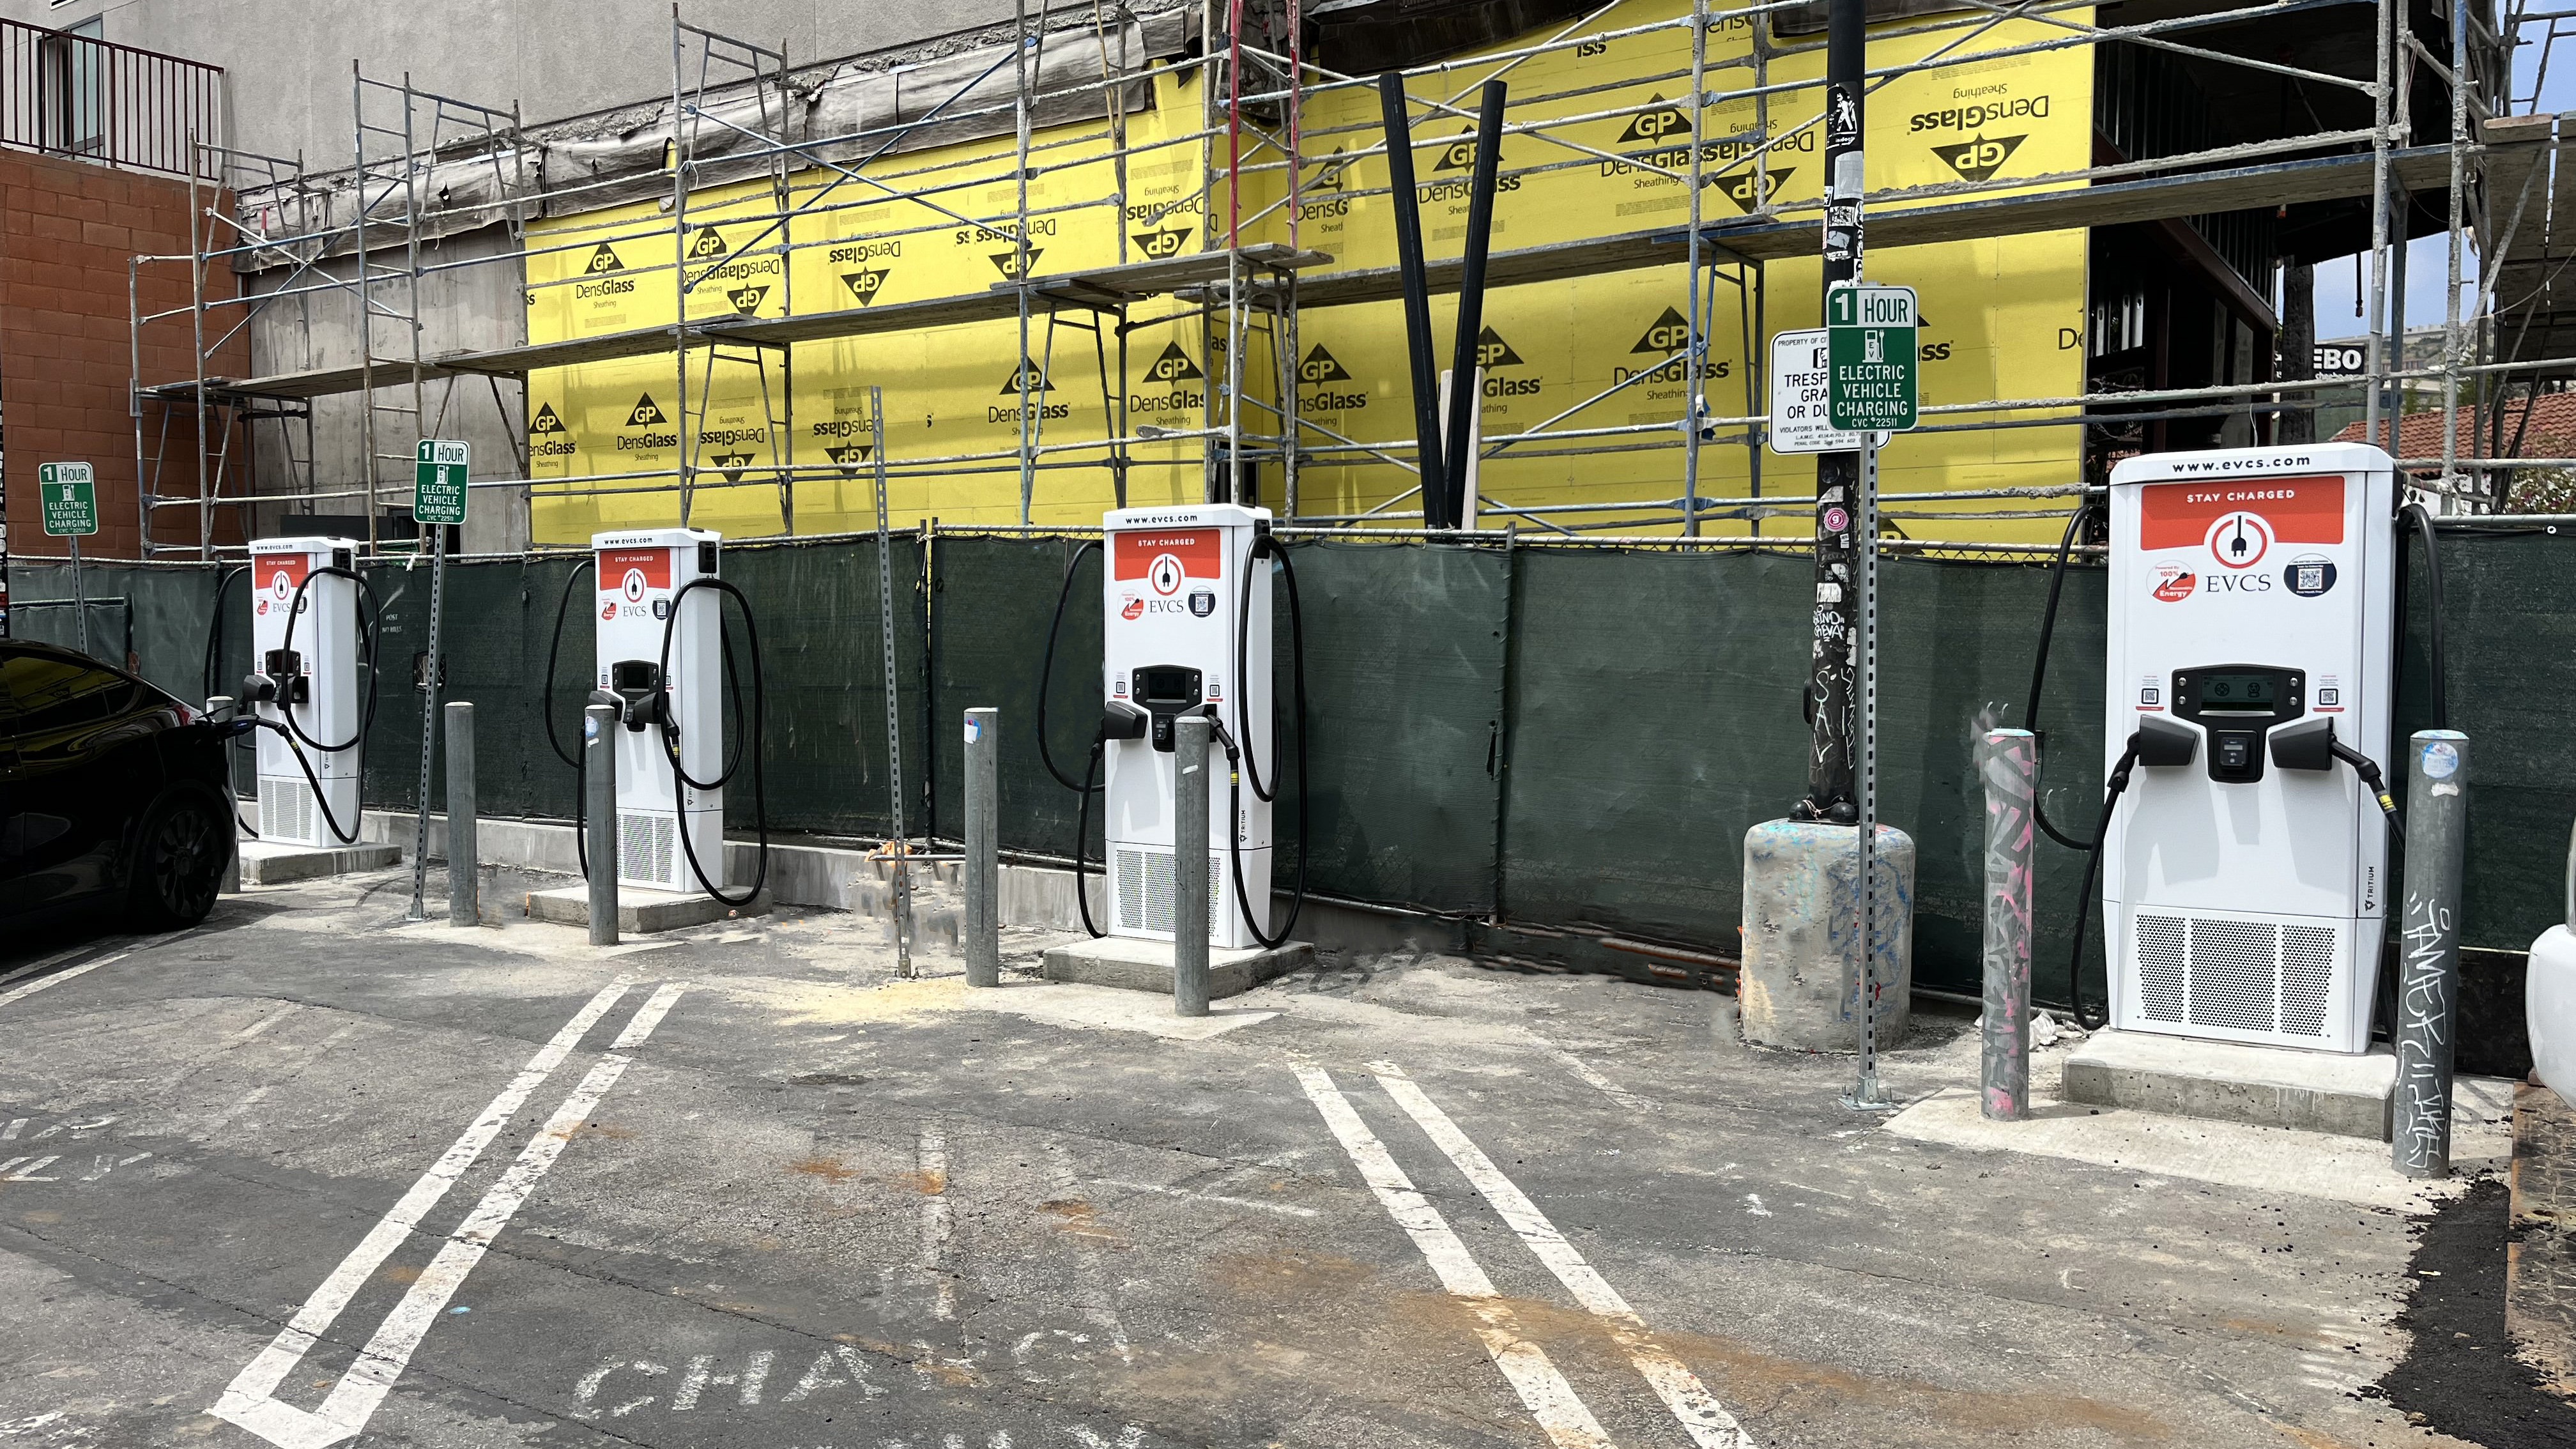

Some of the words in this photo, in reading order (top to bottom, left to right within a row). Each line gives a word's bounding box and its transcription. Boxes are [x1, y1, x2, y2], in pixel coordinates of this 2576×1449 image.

[1953, 84, 2007, 99] Sheathing
[1910, 96, 2049, 132] DensGlass
[1636, 111, 1676, 135] GP
[1955, 142, 2005, 169] GP
[1145, 185, 1179, 195] Sheathing
[697, 237, 719, 254] GP
[1147, 233, 1179, 254] GP
[829, 241, 901, 264] DensGlass
[593, 253, 614, 272] GP
[576, 280, 634, 298] DensGlass
[697, 286, 722, 295] Sheathing
[853, 273, 880, 293] GP
[594, 300, 616, 309] Sheathing
[737, 290, 760, 307] GP
[1836, 293, 1848, 321] 1
[1865, 298, 1908, 323] HOUR
[1648, 326, 1688, 348] GP
[1156, 360, 1188, 378] GP
[1301, 361, 1335, 380] GP
[1839, 365, 1905, 380] ELECTRIC
[1843, 383, 1901, 398] VEHICLE
[634, 407, 656, 422] GP
[1788, 406, 1805, 418] OR
[1837, 401, 1908, 416] CHARGING
[535, 416, 556, 431] GP
[813, 418, 874, 437] ensGlass
[1156, 417, 1191, 425] Sheathing
[1852, 418, 1868, 427] CVC
[618, 433, 677, 450] DensGlass
[701, 428, 764, 445] DensGlass
[422, 443, 429, 459] 1
[438, 447, 464, 462] HOUR
[529, 441, 576, 457] ensGlass
[536, 460, 558, 468] Sheathing
[635, 453, 658, 461] Sheathing
[2172, 456, 2310, 473] www.evcs.com
[44, 466, 52, 480] 1
[61, 468, 88, 481] HOUR
[421, 484, 460, 494] ELECTRIC
[2187, 493, 2220, 503] STAY
[2227, 489, 2295, 502] CHARGED
[49, 502, 88, 510] ELECTRIC
[423, 495, 457, 505] VEHICLE
[52, 510, 87, 519] VEHICLE
[418, 505, 461, 515] CHARGING
[49, 519, 91, 528] CHARGING
[1126, 514, 1197, 524] www.evcs.com
[2205, 574, 2271, 593] EVCS
[273, 603, 290, 613] EVCS
[623, 606, 647, 617] EVCS
[1150, 600, 1184, 613] EVCS
